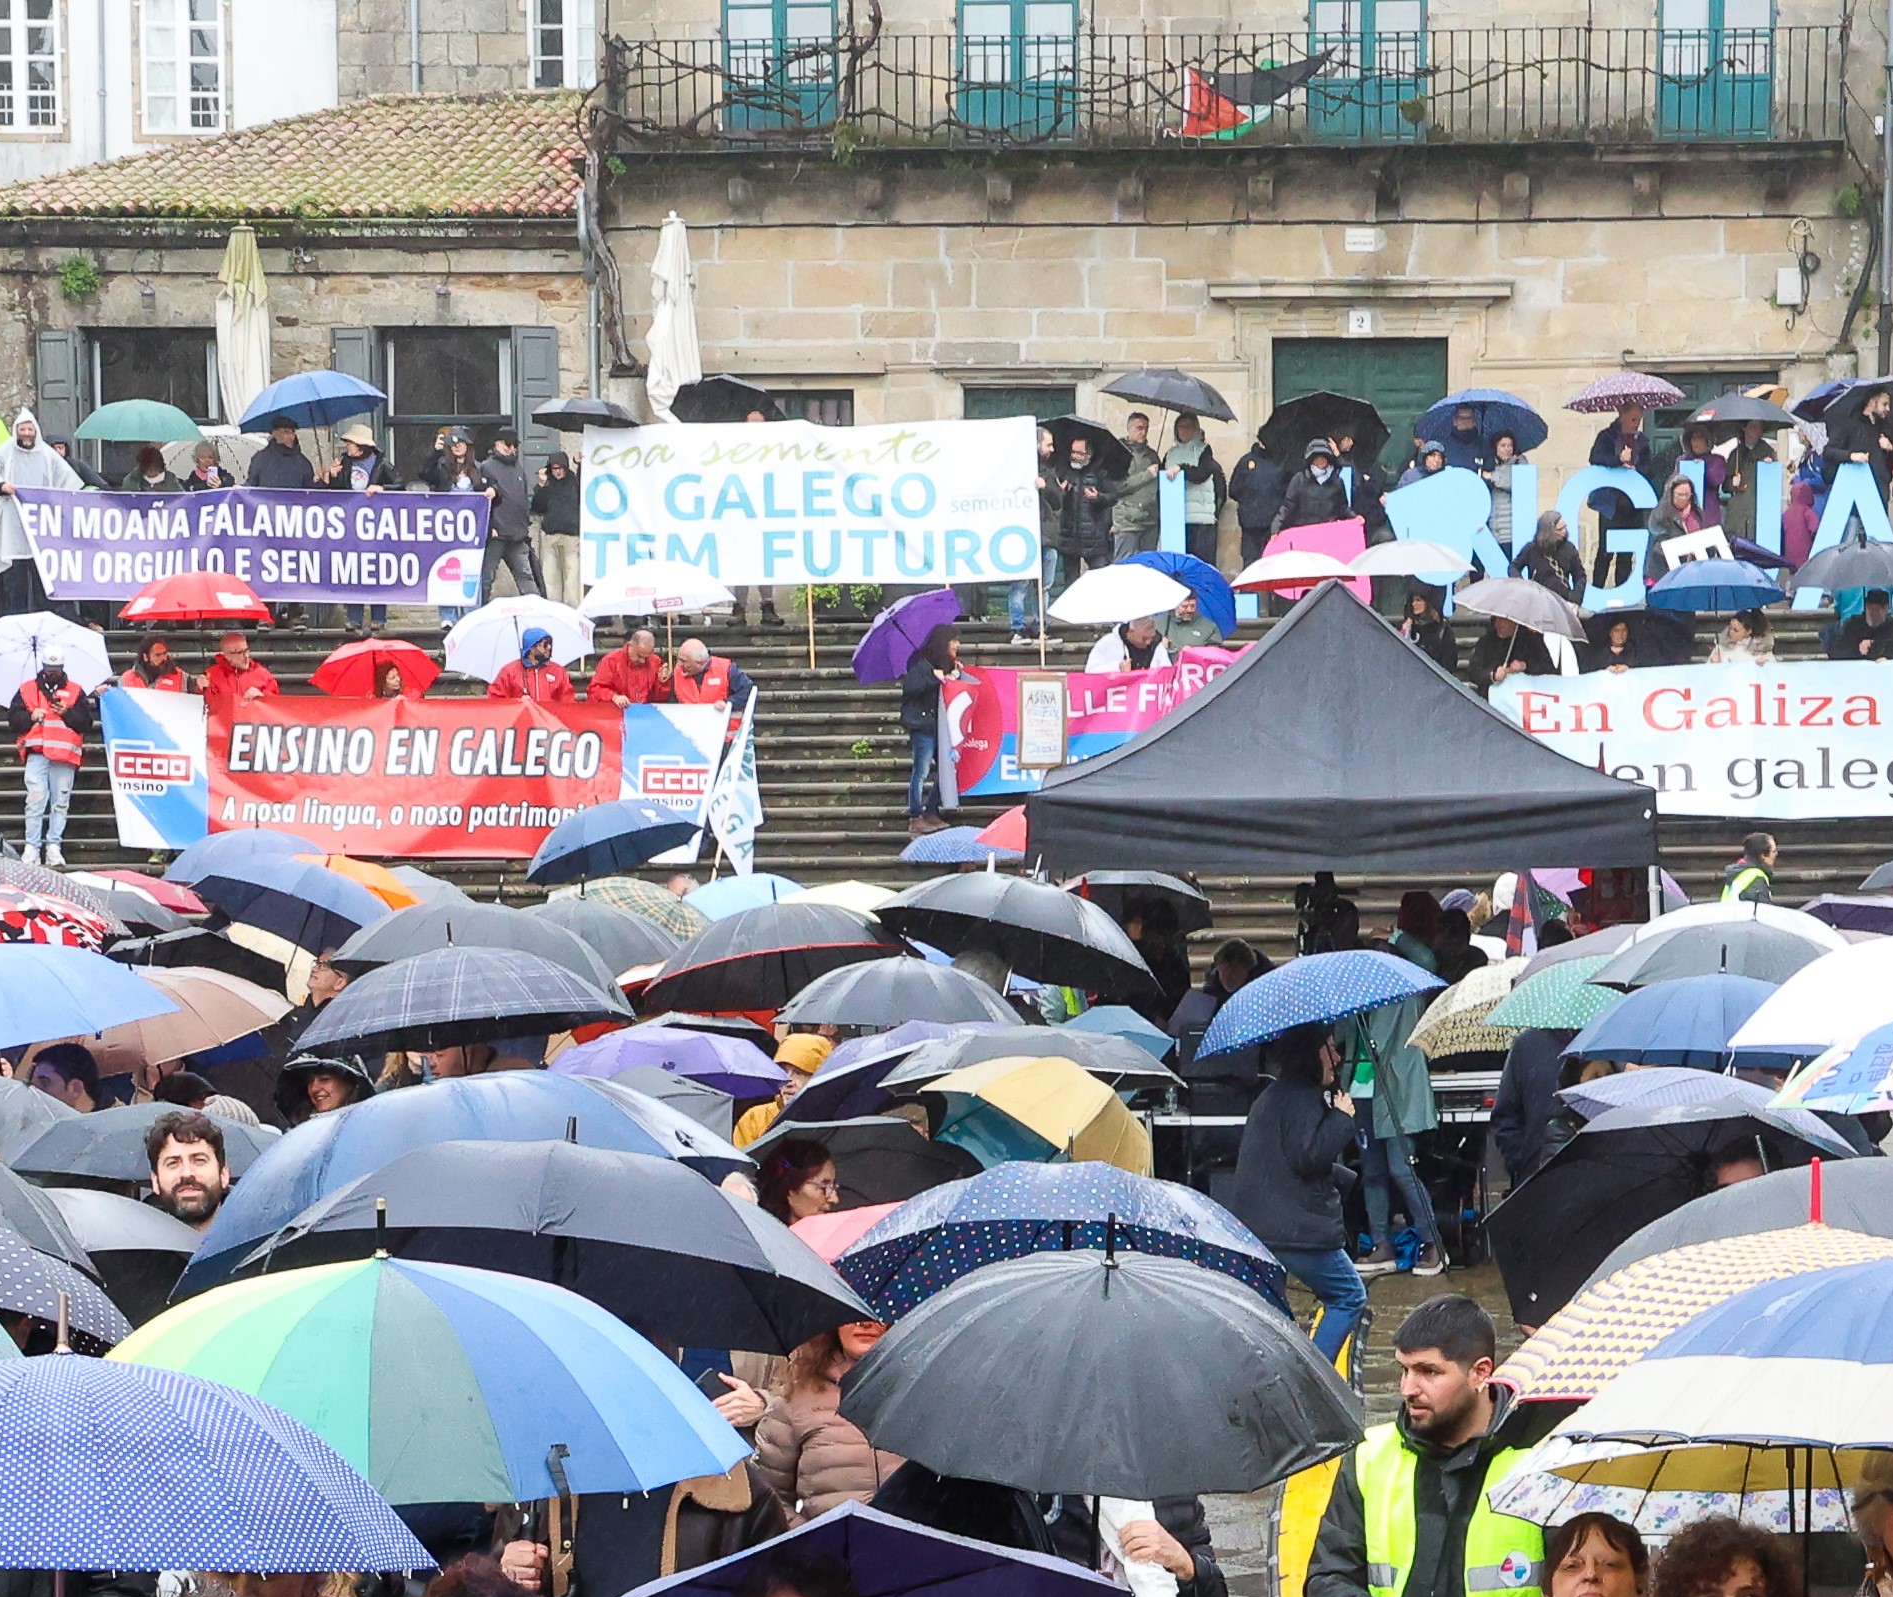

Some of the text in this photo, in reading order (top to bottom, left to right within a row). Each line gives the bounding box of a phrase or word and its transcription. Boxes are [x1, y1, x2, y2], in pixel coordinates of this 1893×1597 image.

[589, 428, 941, 470] coa semente
[584, 470, 937, 522] O GALEGO
[950, 486, 1034, 513] semente
[22, 499, 480, 546] EN MOAÑA FALAMOS GALEGO,
[40, 547, 83, 583] ON
[234, 547, 252, 582] E
[260, 548, 321, 584] SEN
[330, 550, 420, 587] MEDO
[762, 525, 1038, 578] FUTURO
[1515, 682, 1882, 733] En Galiza
[118, 756, 188, 777] CCOO
[228, 723, 602, 779] ENSINO EN GALEGO
[221, 796, 236, 821] A
[241, 800, 297, 824] nosa
[301, 797, 384, 832] lingua,
[389, 804, 405, 826] o
[409, 803, 463, 826] noso
